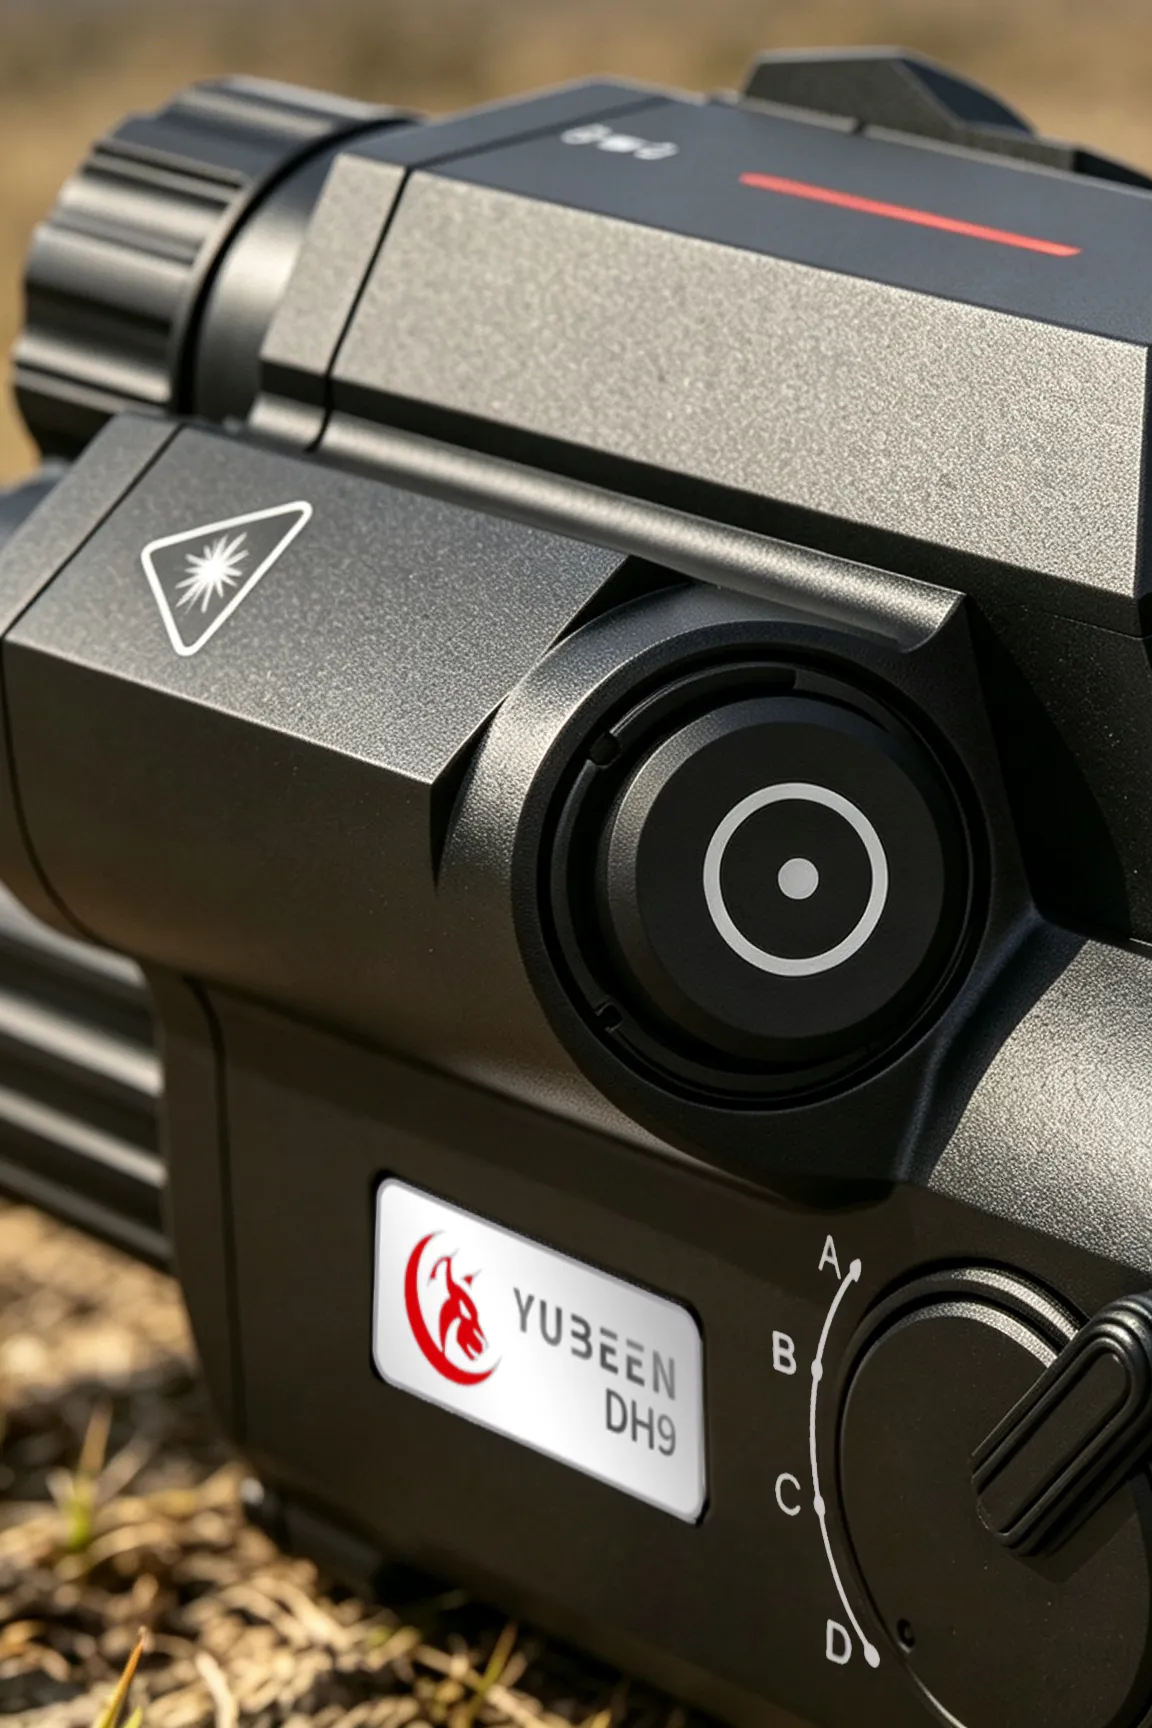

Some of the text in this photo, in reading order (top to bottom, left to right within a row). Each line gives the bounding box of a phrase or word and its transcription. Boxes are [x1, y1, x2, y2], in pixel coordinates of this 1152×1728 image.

[818, 1234, 841, 1280] A
[513, 1286, 676, 1401] YUBEEN
[772, 1330, 798, 1375] B
[605, 1388, 677, 1457] DH9
[775, 1472, 801, 1516] C
[826, 1618, 852, 1665] D
